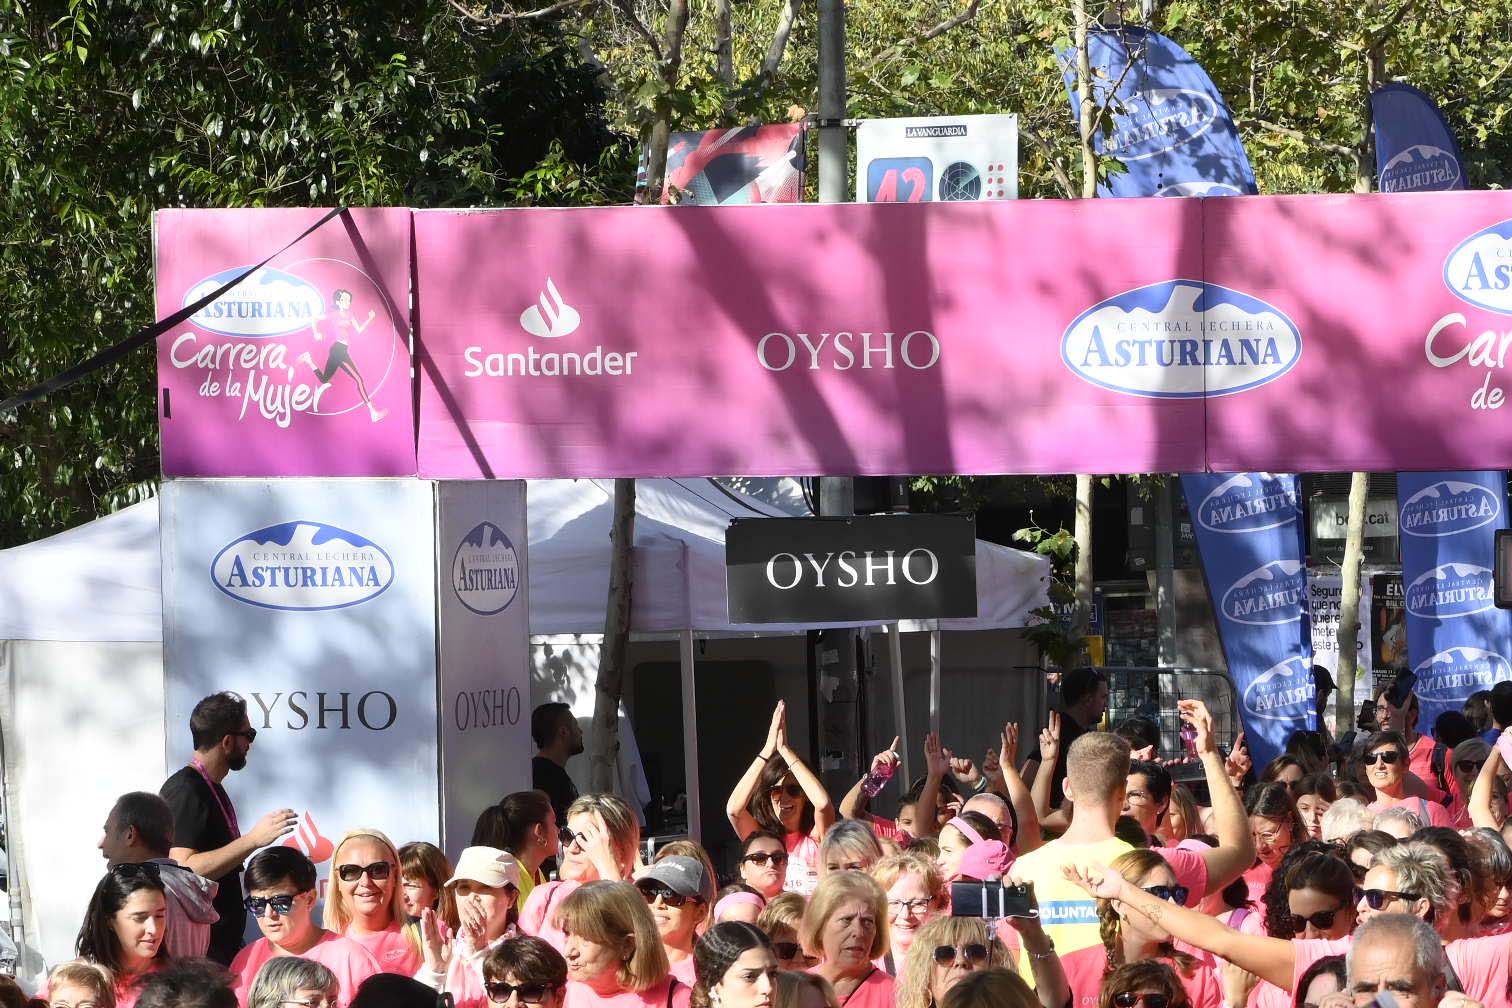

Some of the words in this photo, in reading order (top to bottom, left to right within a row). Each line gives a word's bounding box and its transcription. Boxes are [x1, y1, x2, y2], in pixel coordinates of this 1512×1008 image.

[1116, 322, 1192, 332] CENTRAL
[1199, 319, 1275, 332] LECHERA
[170, 332, 287, 370] Carrera
[464, 344, 638, 378] Santander
[756, 330, 941, 371] OYSHO
[1080, 324, 1284, 367] ASTURIANA
[199, 371, 221, 397] de
[225, 371, 242, 397] la
[238, 366, 332, 428] Mujer
[1470, 372, 1505, 410] de
[224, 554, 381, 588] ASTURIANA
[252, 552, 312, 562] CENTRAL
[315, 552, 376, 562] LECHERA
[457, 556, 516, 592] ASTURIANA
[766, 547, 939, 590] OYSHO
[1312, 600, 1329, 611] que
[1313, 641, 1331, 650] este
[228, 690, 397, 731] YSHO
[454, 686, 521, 731] OYSHO
